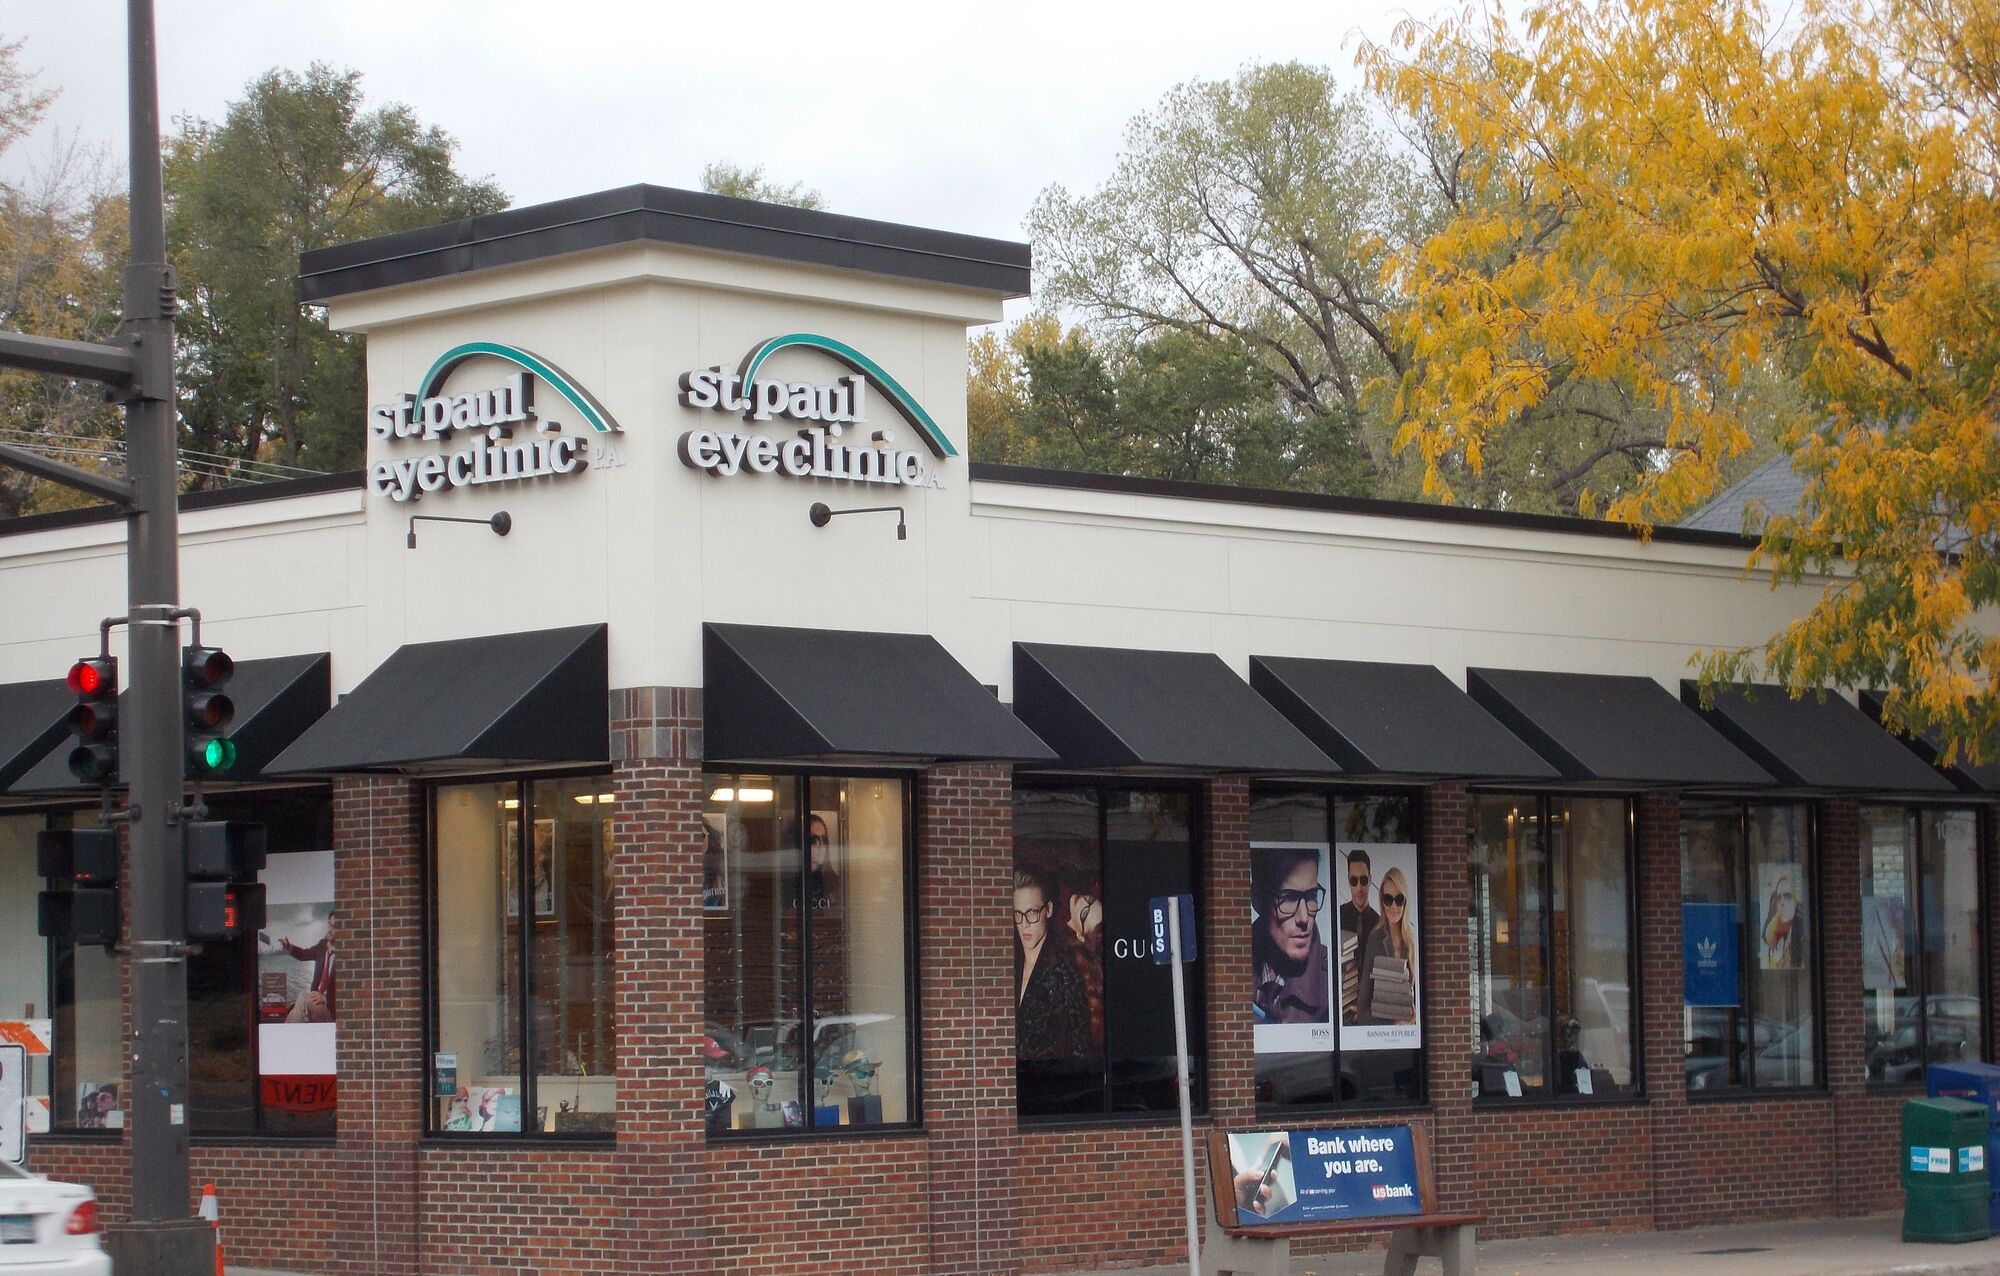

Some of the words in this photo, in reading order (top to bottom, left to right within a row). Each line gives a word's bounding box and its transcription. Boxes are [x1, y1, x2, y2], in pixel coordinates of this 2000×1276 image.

[1153, 908, 1165, 953] BUS
[1114, 938, 1154, 959] GU
[1307, 1136, 1347, 1155] Bank
[1347, 1135, 1394, 1153] where
[1323, 1160, 1352, 1179] you
[1354, 1158, 1383, 1174] are.
